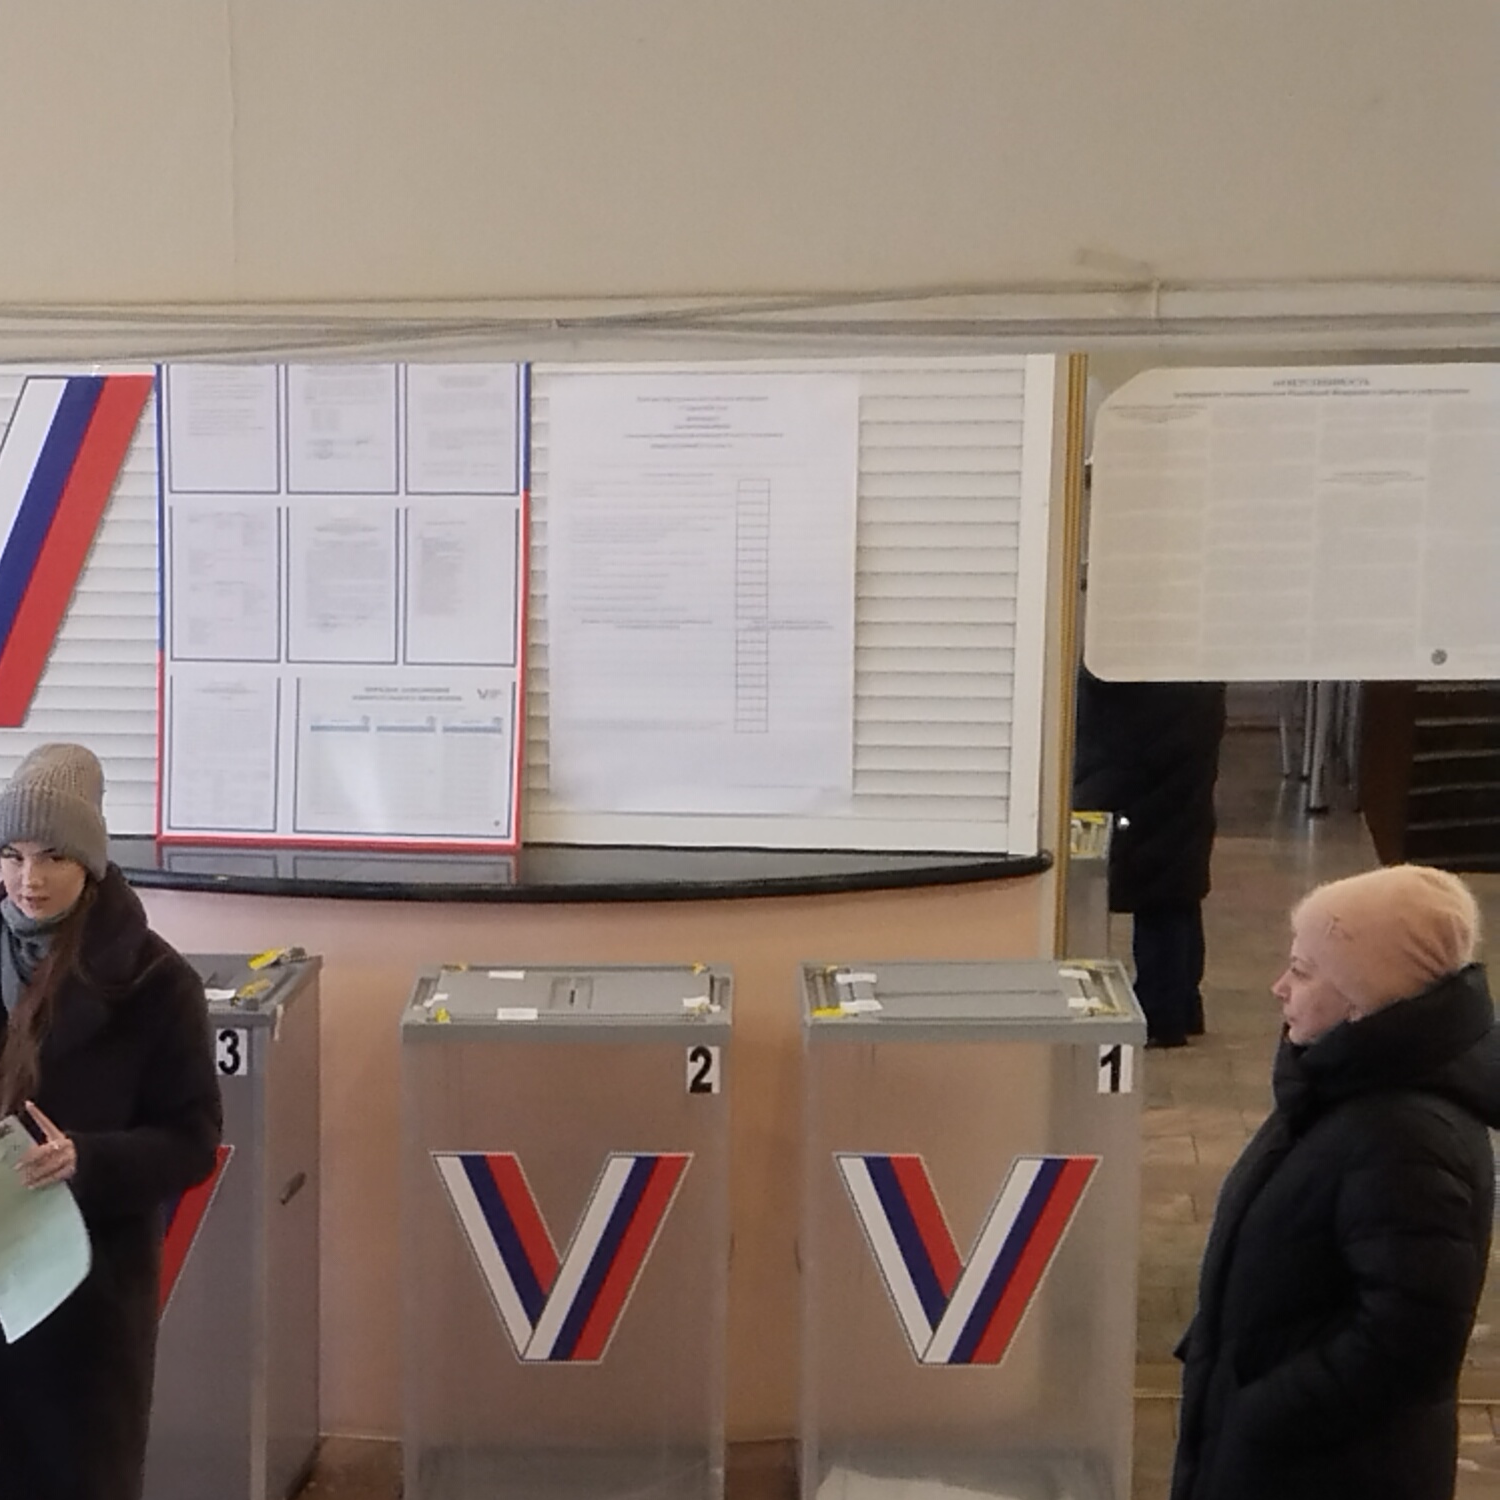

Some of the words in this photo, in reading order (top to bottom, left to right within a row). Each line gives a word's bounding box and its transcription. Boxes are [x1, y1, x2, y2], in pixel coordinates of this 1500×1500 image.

[218, 1029, 241, 1075] 3
[688, 1046, 713, 1093] 2
[1100, 1045, 1122, 1093] 1
